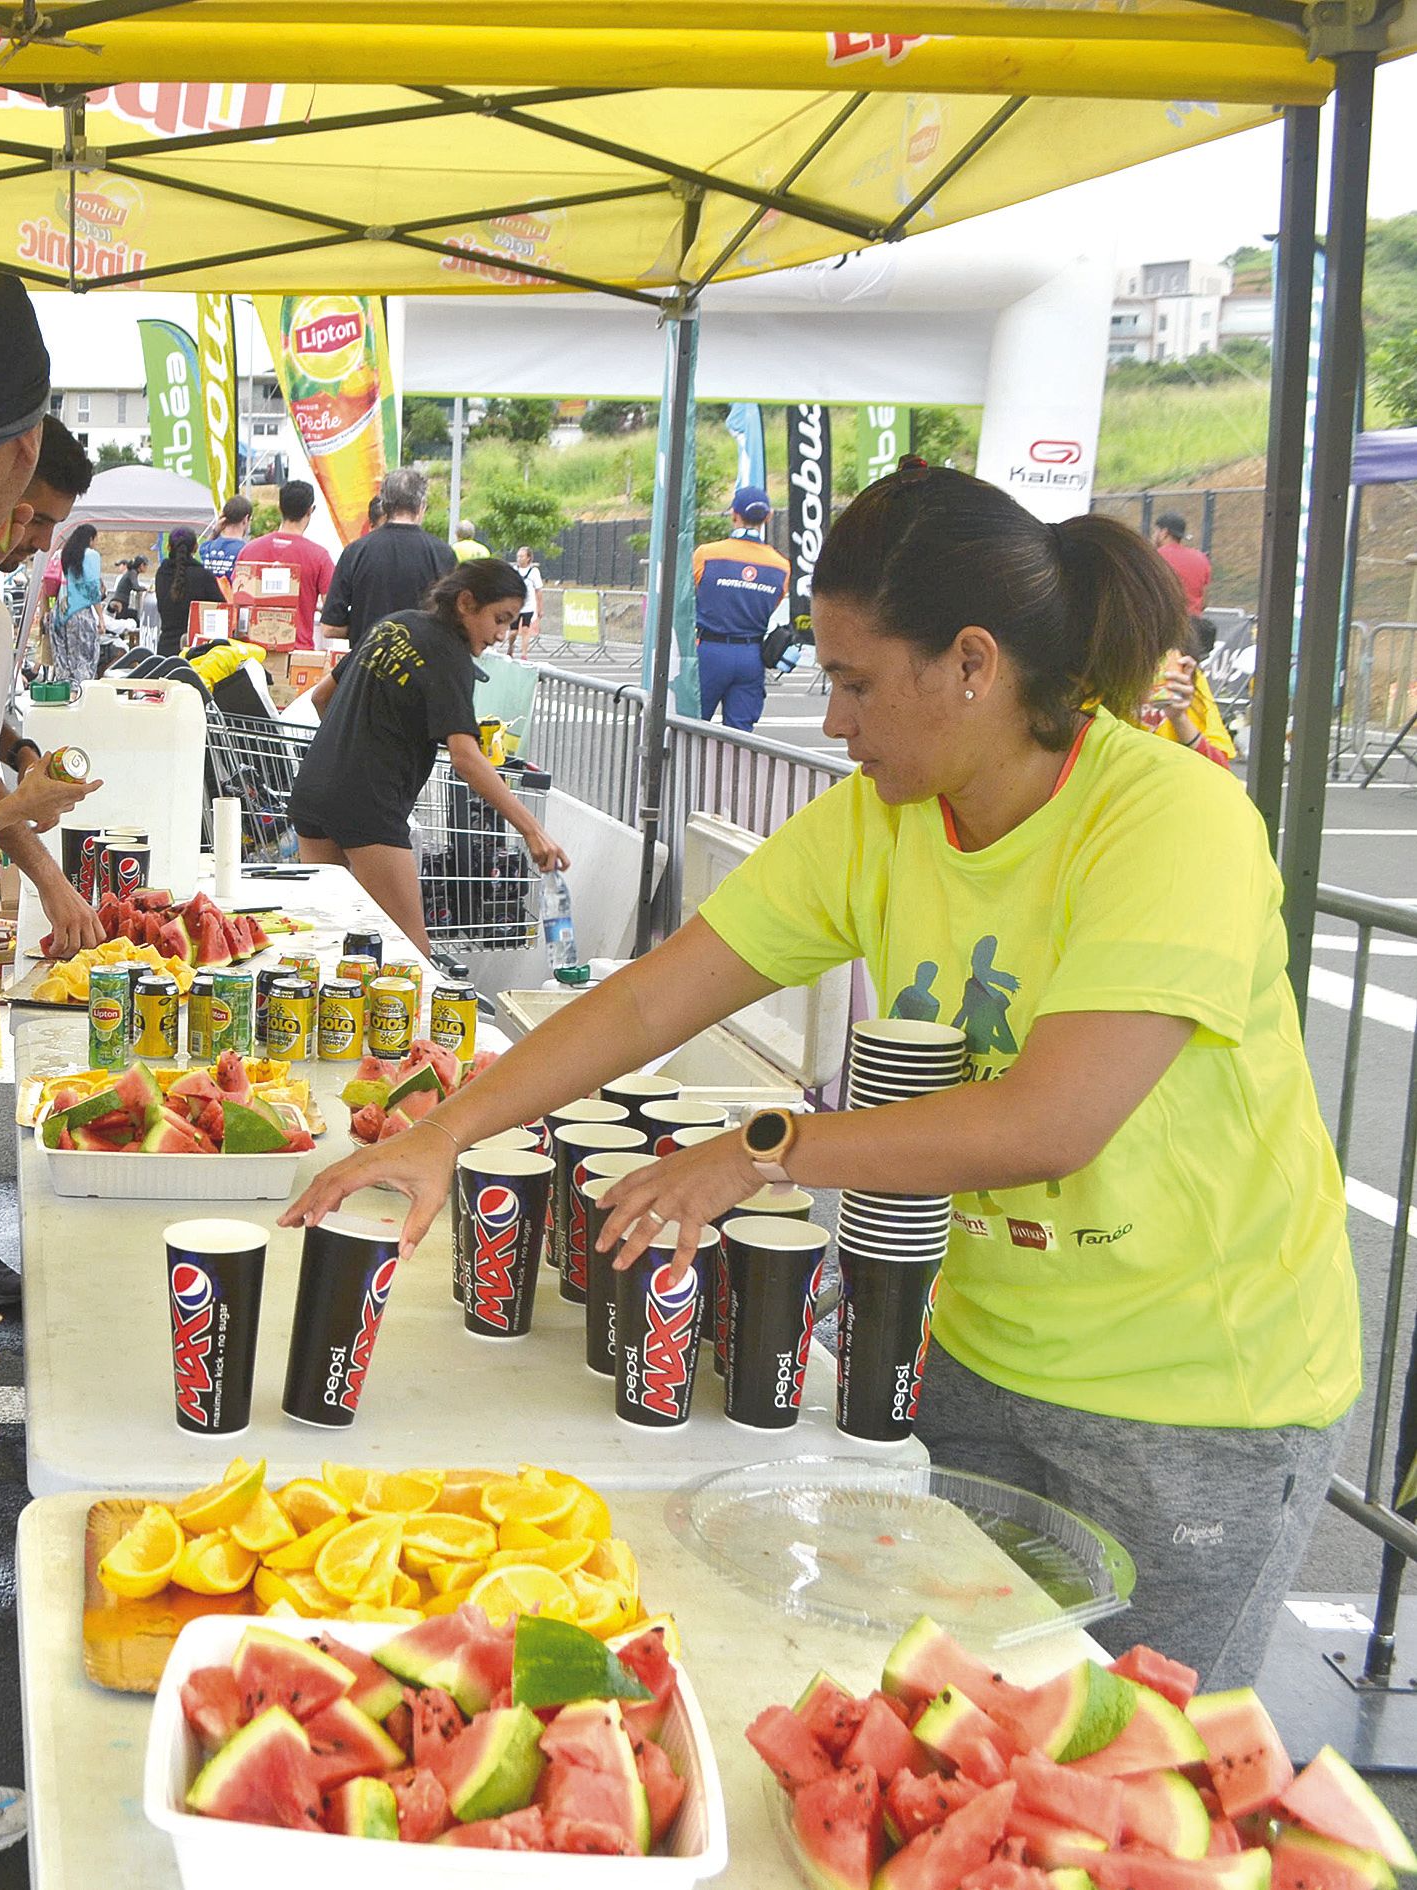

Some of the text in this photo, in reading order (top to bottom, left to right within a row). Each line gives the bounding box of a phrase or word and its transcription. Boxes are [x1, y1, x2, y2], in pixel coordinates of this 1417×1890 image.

[301, 320, 358, 349] Lipton
[297, 411, 342, 431] Pêche
[93, 1010, 118, 1018] Lipton
[1070, 1223, 1133, 1247] Tanéo
[474, 1213, 520, 1330] MAX
[845, 1332, 853, 1347] no
[846, 1301, 856, 1330] sugar
[172, 1294, 214, 1427] MAX
[213, 1303, 230, 1428] maximum kick no sugar
[324, 1346, 347, 1405] pepsi
[624, 1345, 639, 1405] pepsi
[641, 1292, 697, 1419] MAX
[774, 1351, 792, 1408] pepsi
[892, 1362, 910, 1420] pepsi
